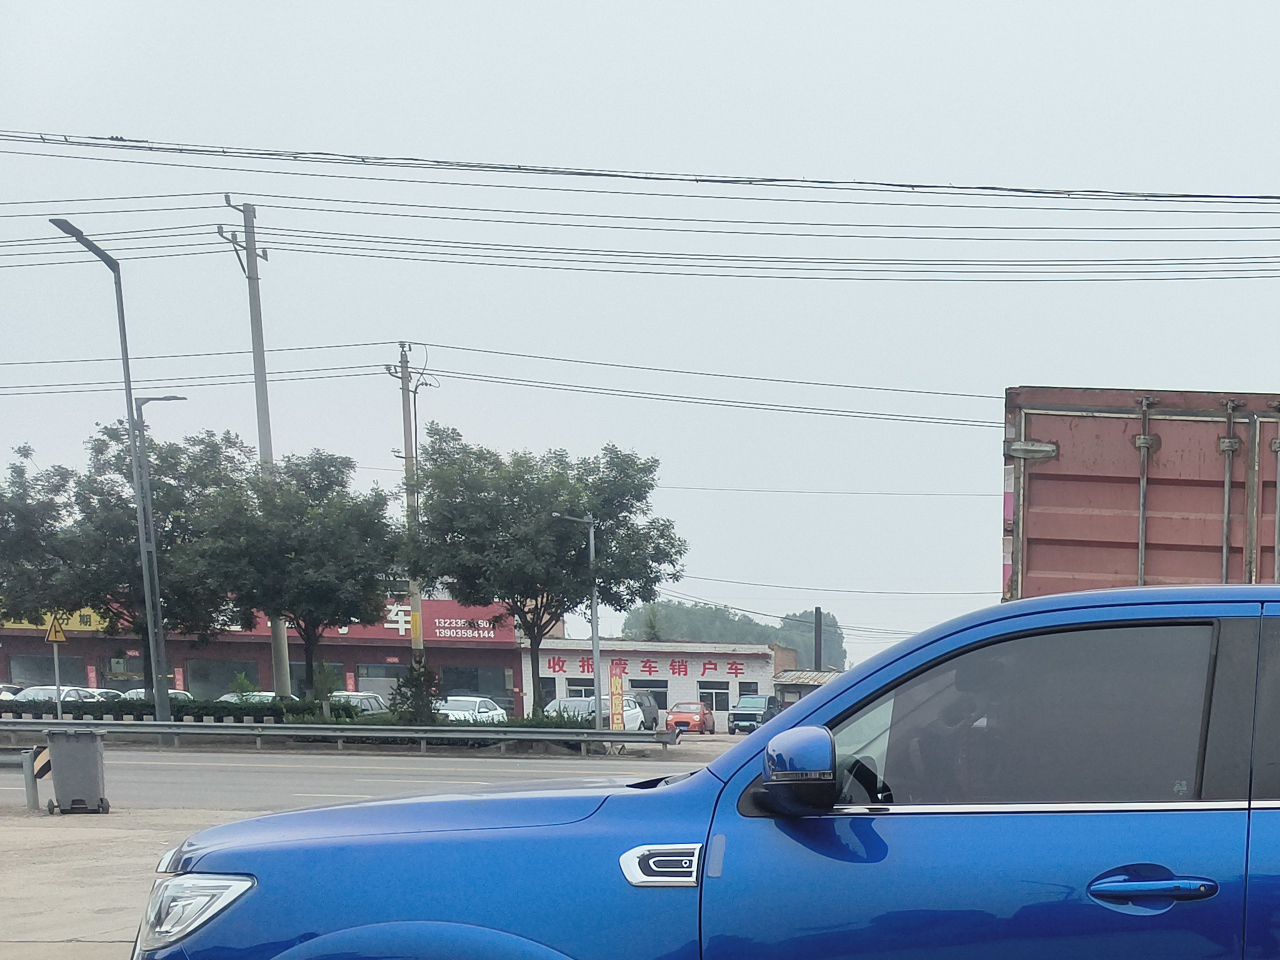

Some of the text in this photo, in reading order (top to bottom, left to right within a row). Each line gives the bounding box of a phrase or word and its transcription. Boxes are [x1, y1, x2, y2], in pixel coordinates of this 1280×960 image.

[434, 629, 495, 638] 13903584144
[547, 656, 745, 678] 收报废车销户车
